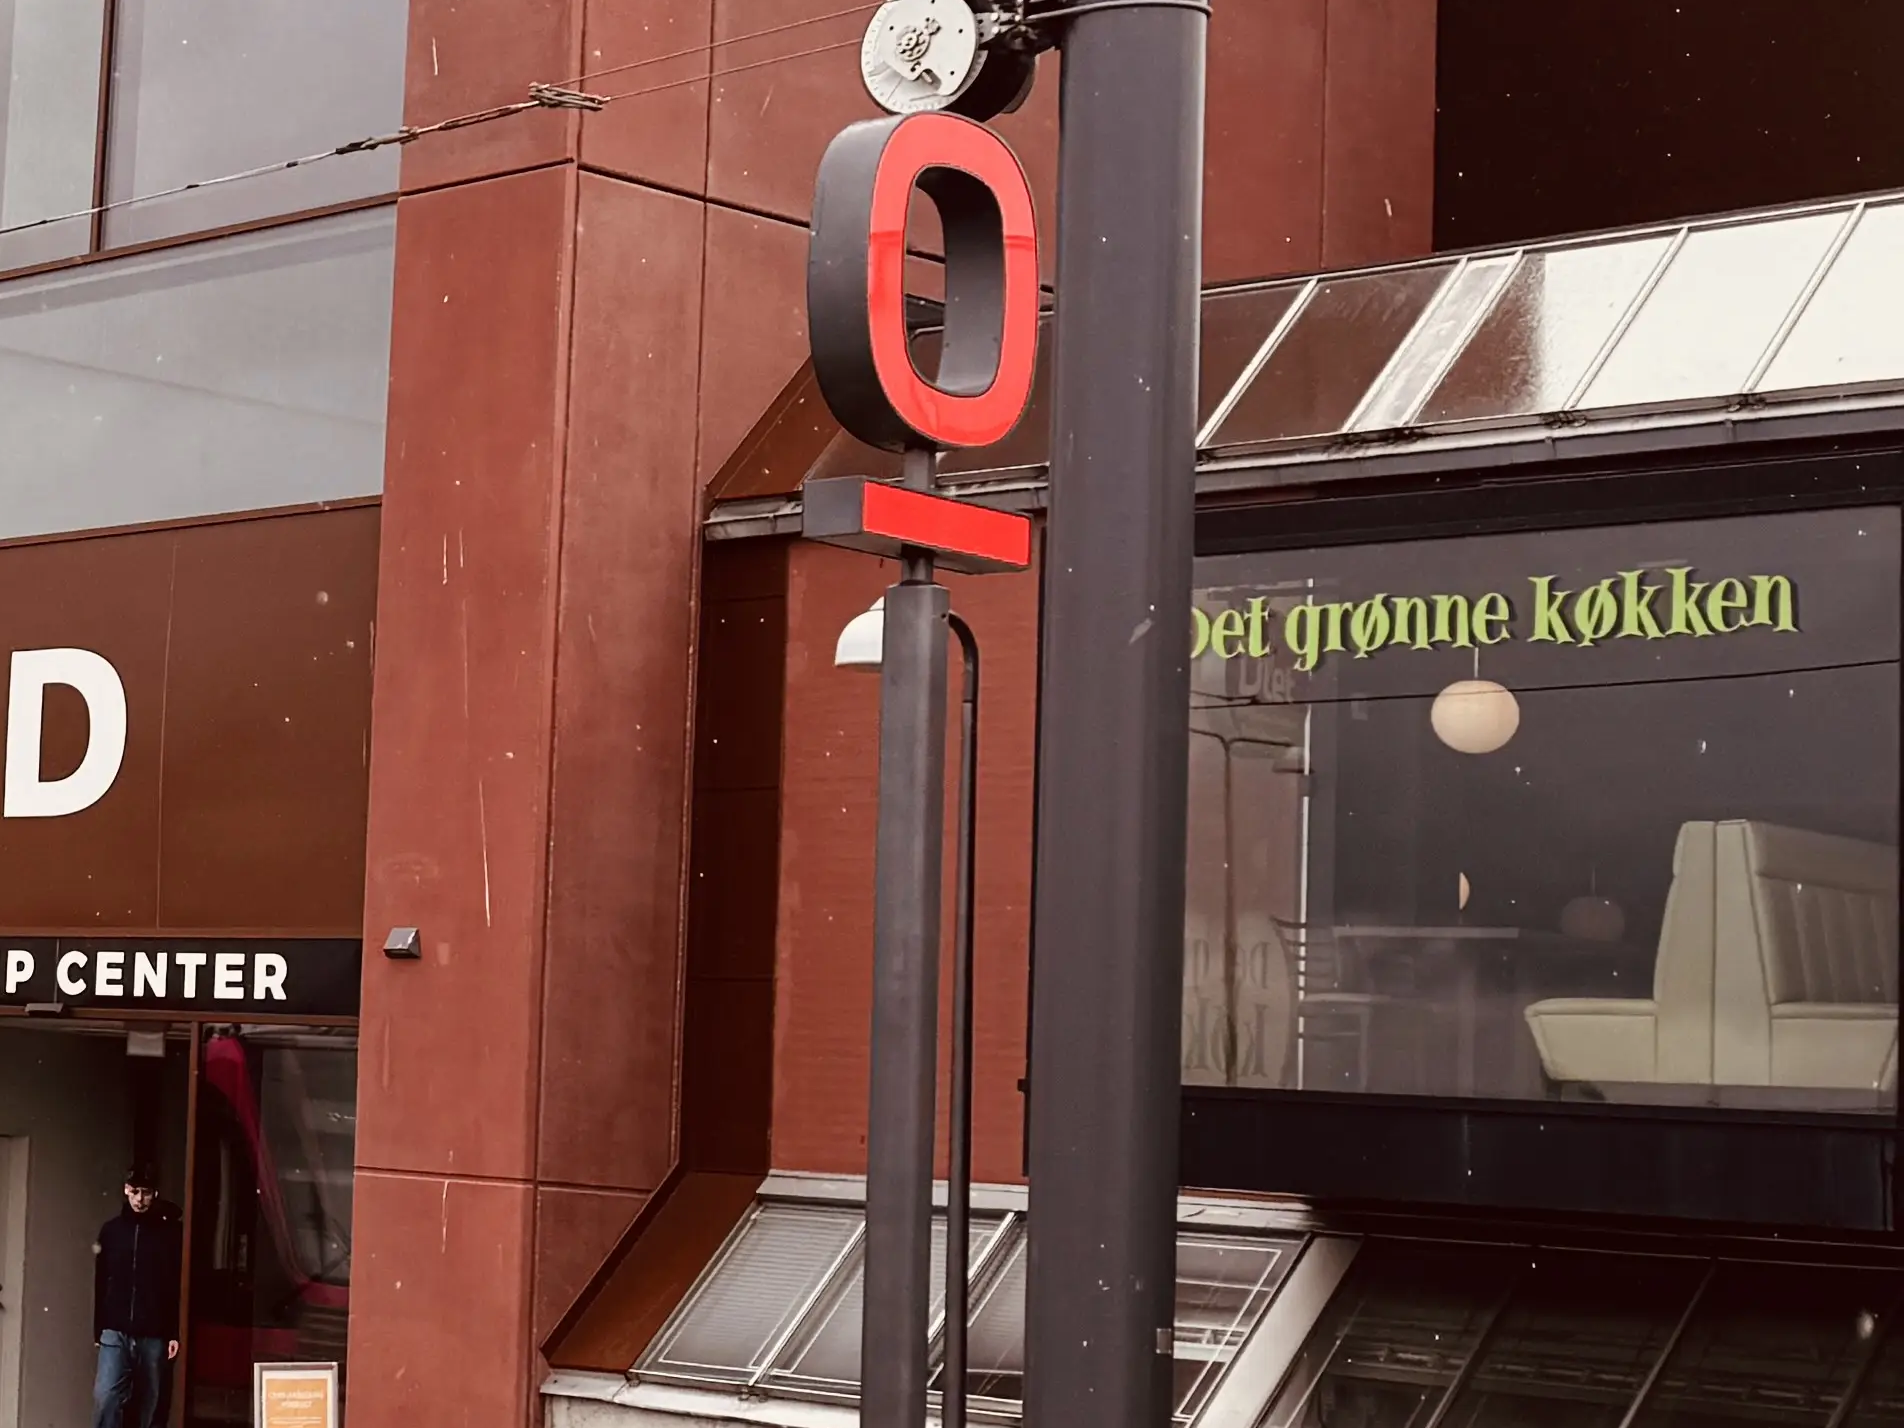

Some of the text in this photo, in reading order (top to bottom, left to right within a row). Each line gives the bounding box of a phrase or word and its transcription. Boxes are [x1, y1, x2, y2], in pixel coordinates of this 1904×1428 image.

[1284, 592, 1509, 670] grønne
[1529, 566, 1797, 646] køkken
[3, 647, 127, 818] D
[56, 950, 288, 1000] CENTER
